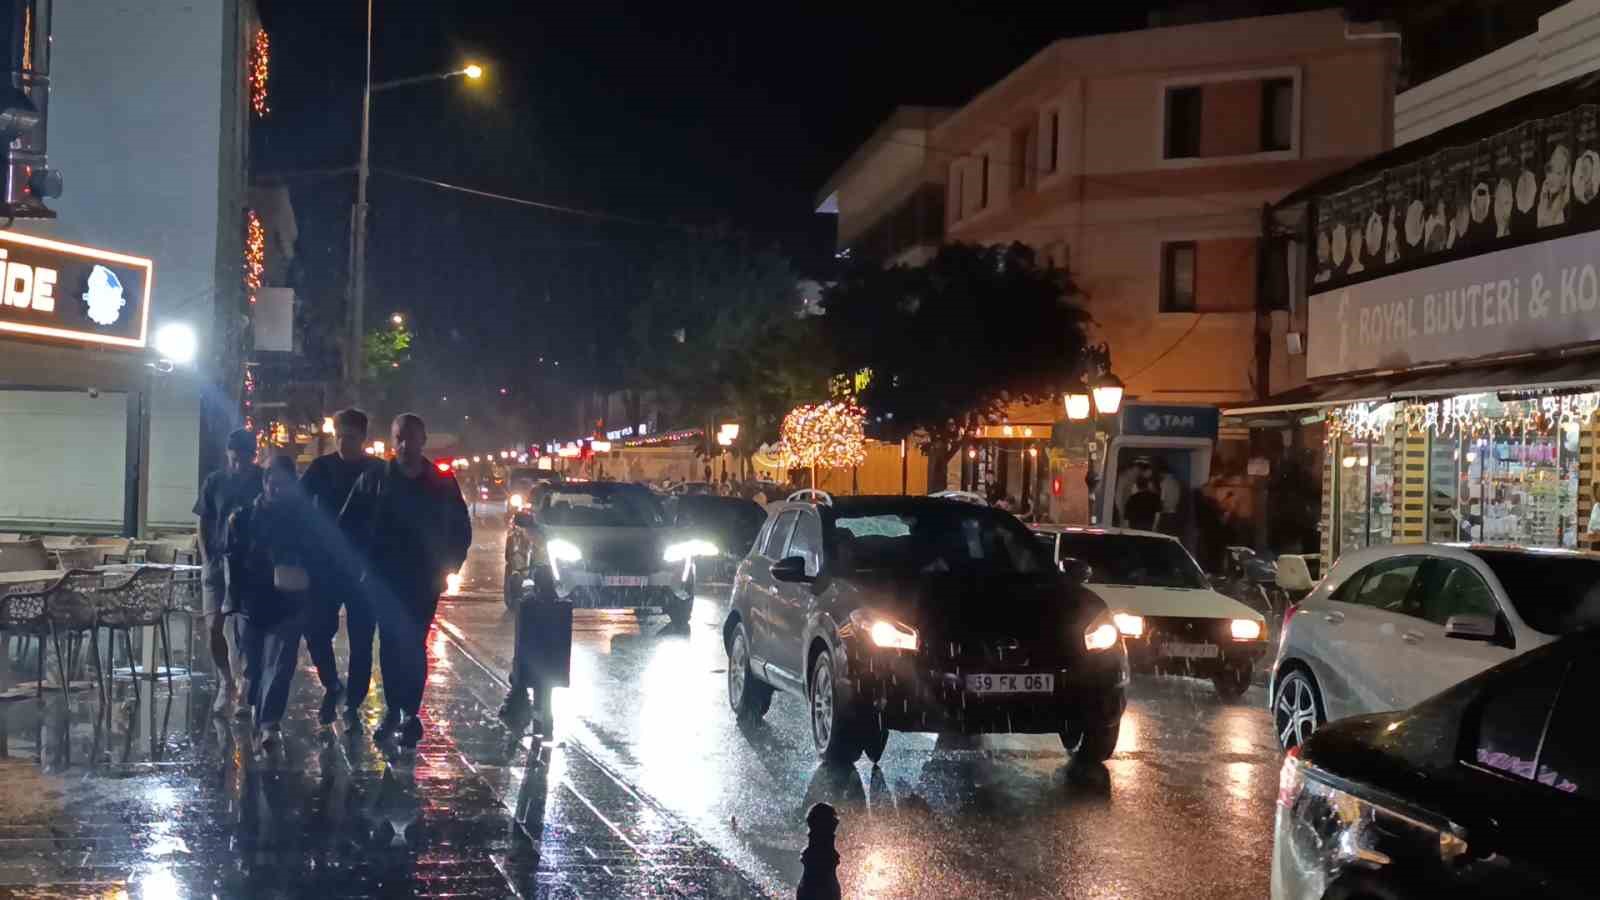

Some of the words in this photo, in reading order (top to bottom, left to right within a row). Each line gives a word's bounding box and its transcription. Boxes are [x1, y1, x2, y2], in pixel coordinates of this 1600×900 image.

[1359, 298, 1417, 345] ROYAL
[1528, 271, 1552, 318] &
[1560, 263, 1600, 315] KO
